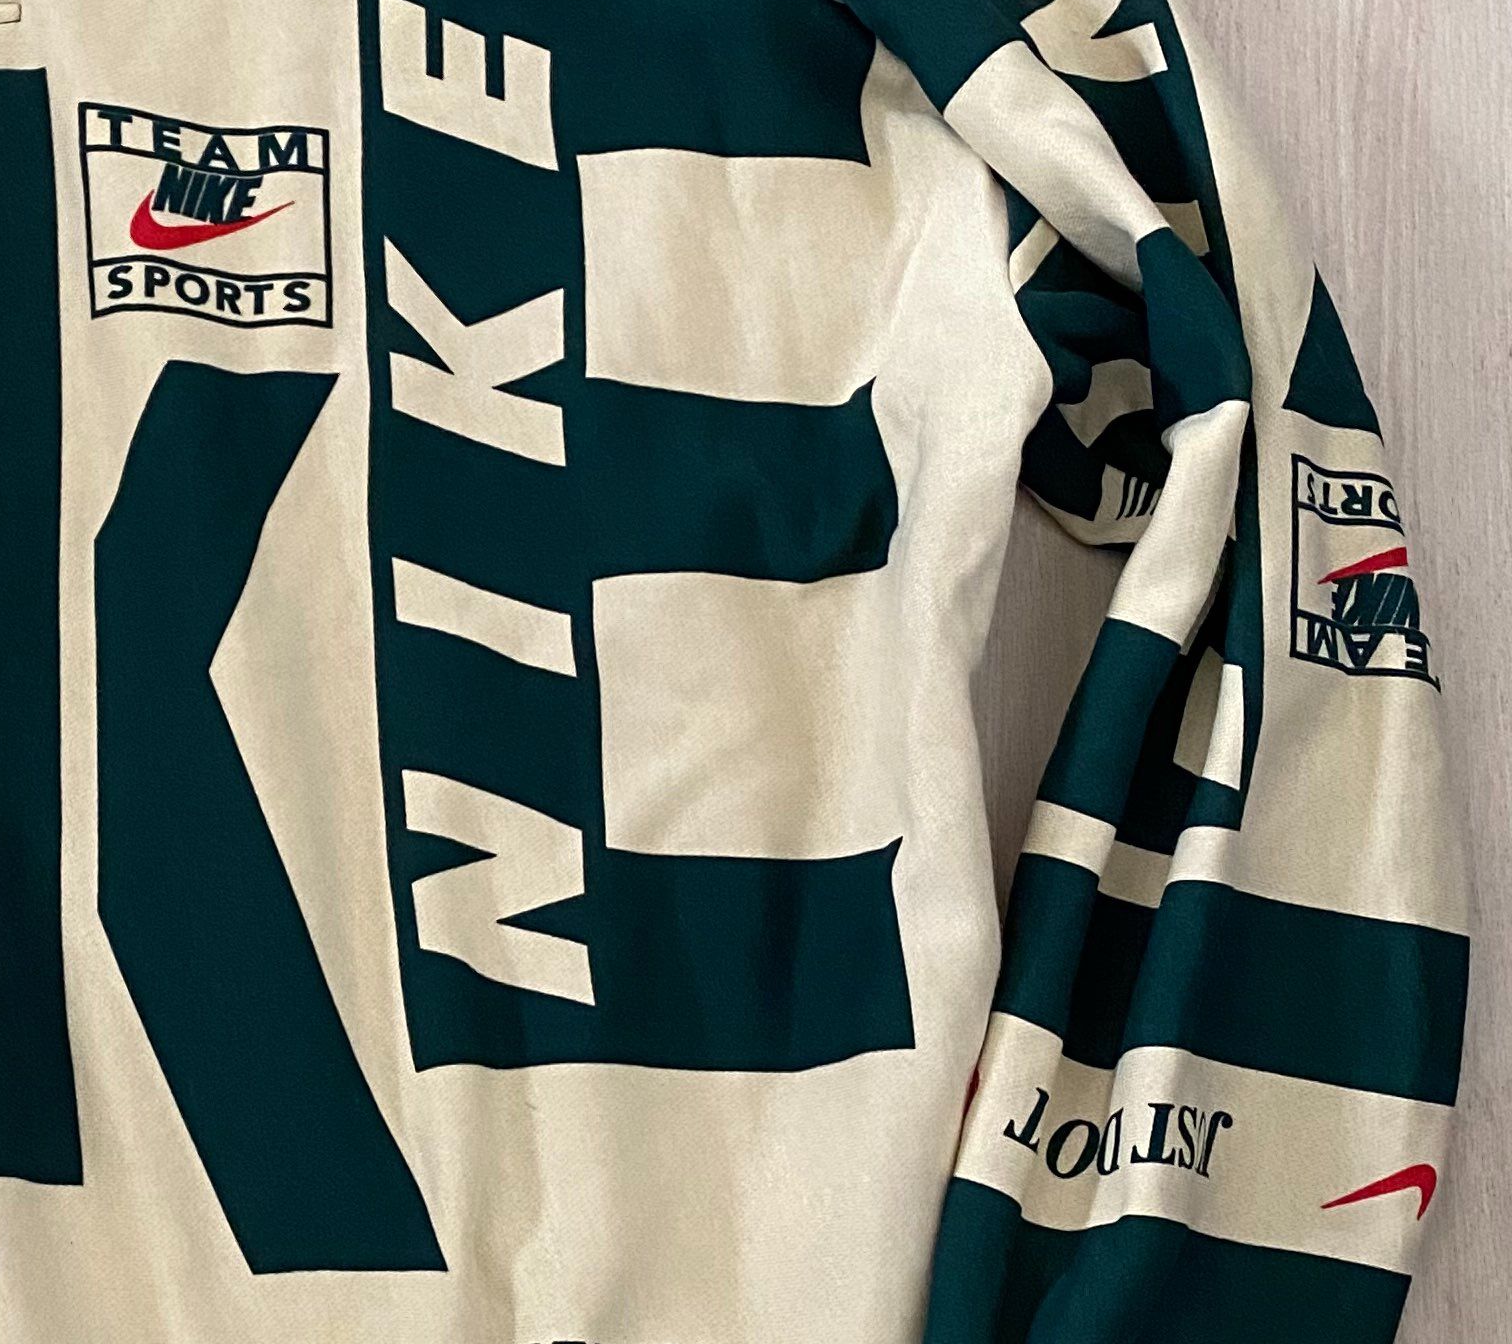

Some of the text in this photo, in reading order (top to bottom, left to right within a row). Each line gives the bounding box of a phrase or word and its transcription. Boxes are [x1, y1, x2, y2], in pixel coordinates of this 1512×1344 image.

[97, 110, 310, 170] TEAM
[151, 163, 264, 226] NIKE
[107, 264, 312, 316] SPORTS
